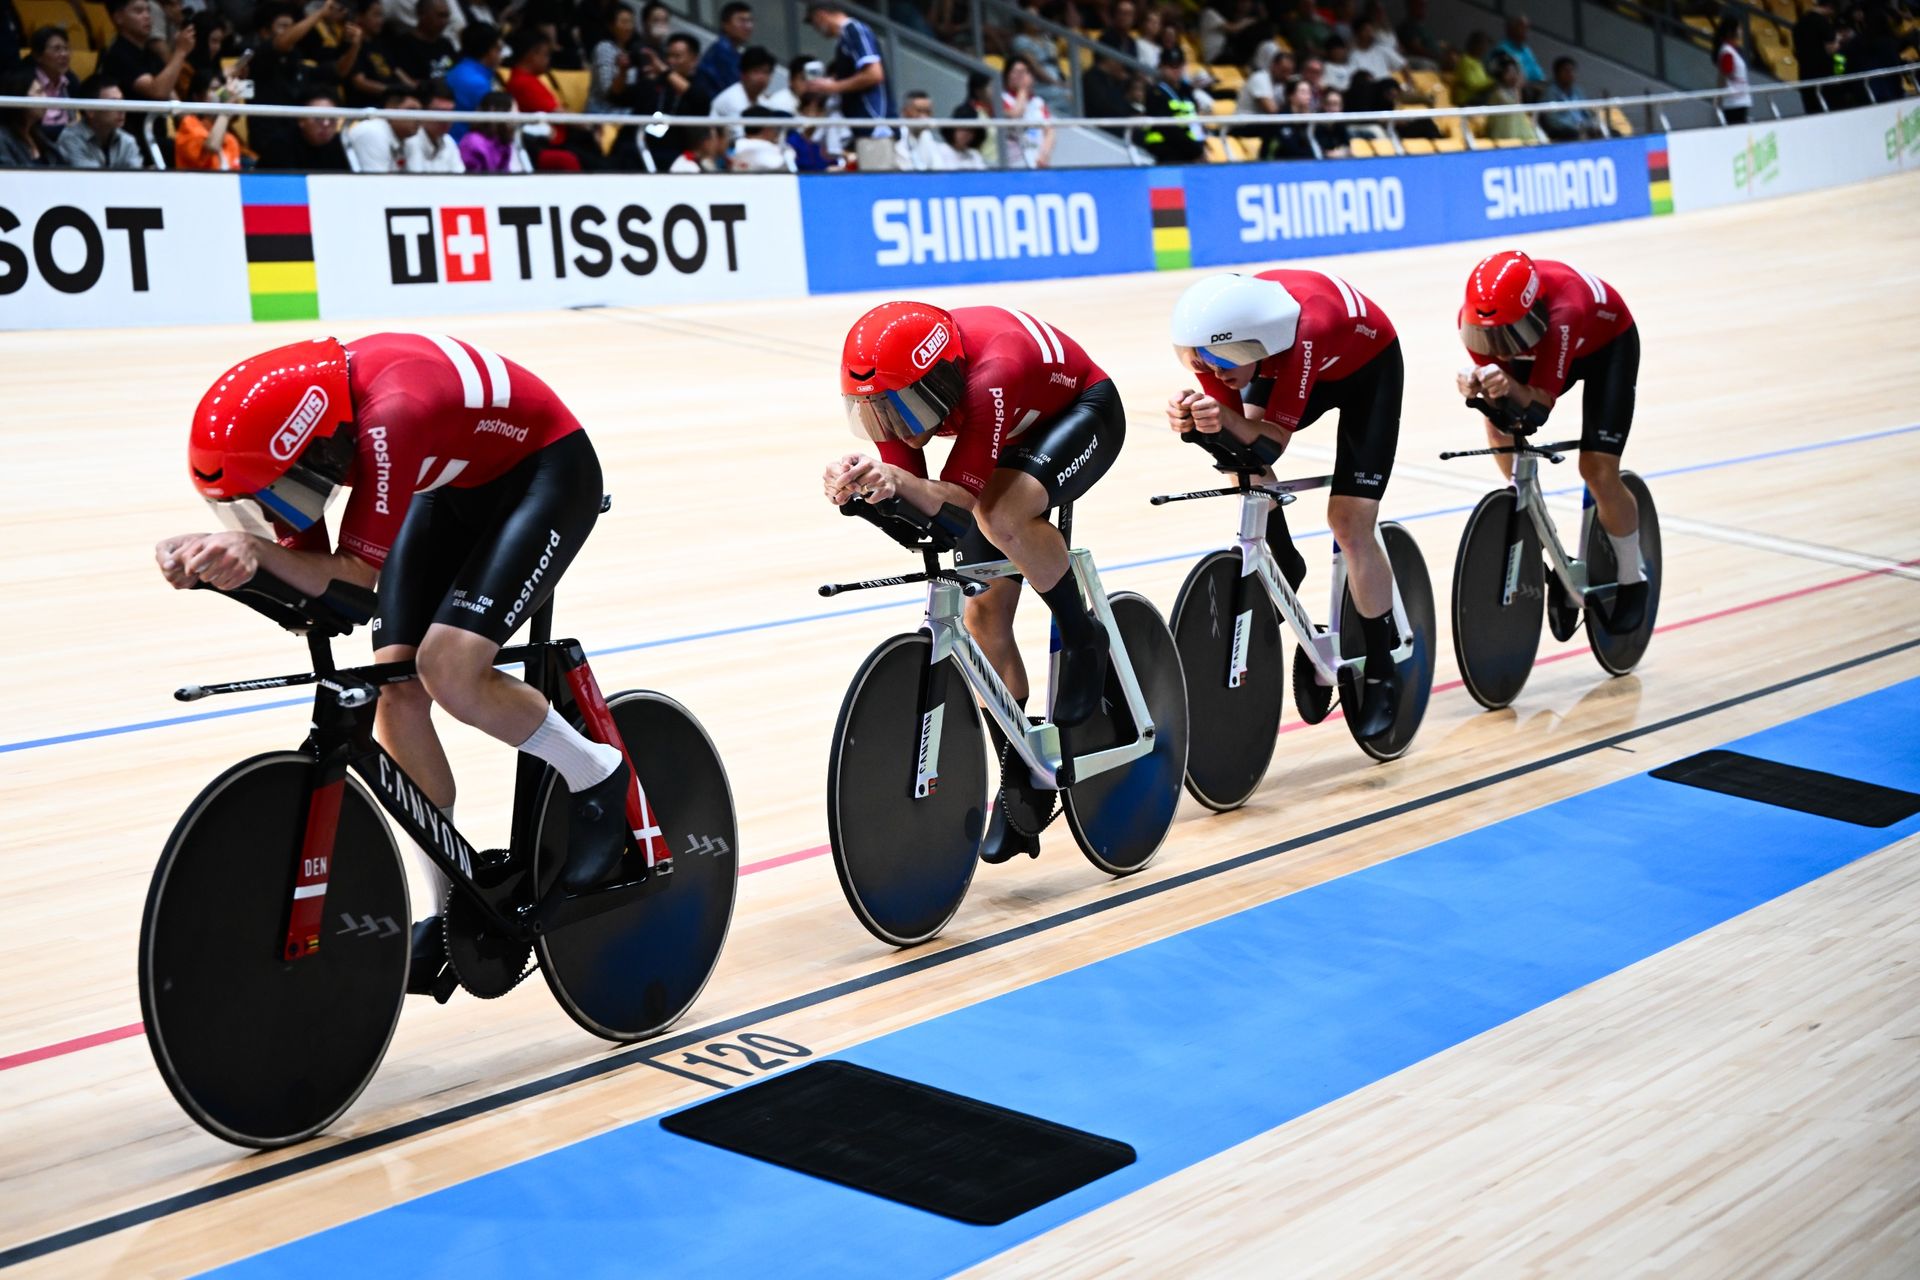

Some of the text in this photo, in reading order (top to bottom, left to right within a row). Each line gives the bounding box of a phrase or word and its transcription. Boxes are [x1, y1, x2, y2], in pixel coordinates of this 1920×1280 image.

[1237, 177, 1405, 243] SHIMANO
[1483, 157, 1617, 220] SHIMANO
[498, 204, 746, 279] TISSOT
[872, 192, 1099, 267] SHIMANO
[918, 327, 947, 364] ABUS
[1211, 331, 1233, 344] poc
[1556, 325, 1570, 379] postnord
[1049, 372, 1078, 389] postnord
[1299, 340, 1313, 399] postnord
[280, 393, 324, 452] ABUS
[474, 418, 530, 443] postnord
[988, 387, 1005, 460] postnord
[367, 426, 393, 515] postnord
[1056, 434, 1099, 487] postnord
[478, 595, 495, 608] FOR
[503, 529, 562, 628] postnord
[859, 576, 907, 589] CANYON
[452, 599, 487, 615] DENMARK
[919, 714, 933, 774] CANYON
[379, 753, 473, 880] CANYON
[304, 856, 328, 877] DEN
[682, 1033, 812, 1077] 120
